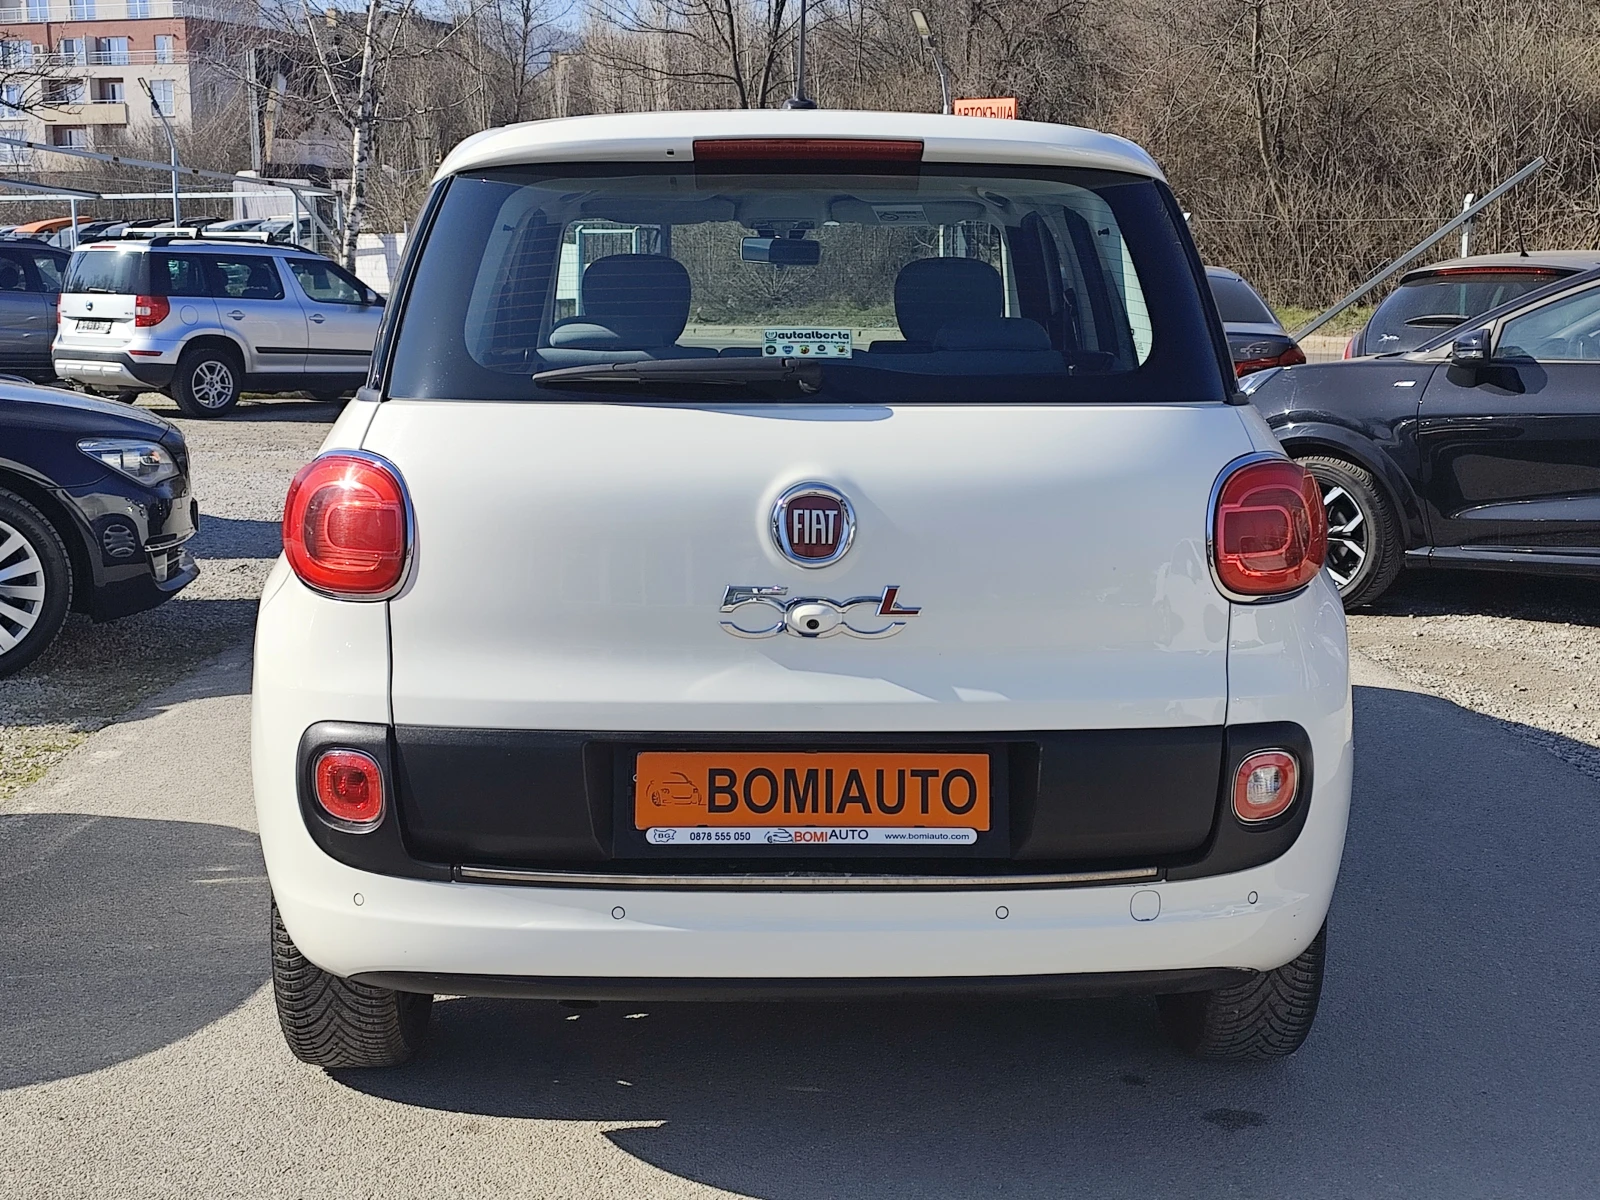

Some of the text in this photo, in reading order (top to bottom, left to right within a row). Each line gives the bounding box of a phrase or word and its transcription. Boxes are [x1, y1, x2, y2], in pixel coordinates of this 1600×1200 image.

[778, 331, 849, 339] autoalberta
[793, 509, 838, 544] FIAT
[707, 767, 977, 815] BOMIAUTO
[689, 831, 751, 841] 0878 555 050
[884, 832, 970, 841] www.bomiauto.com
